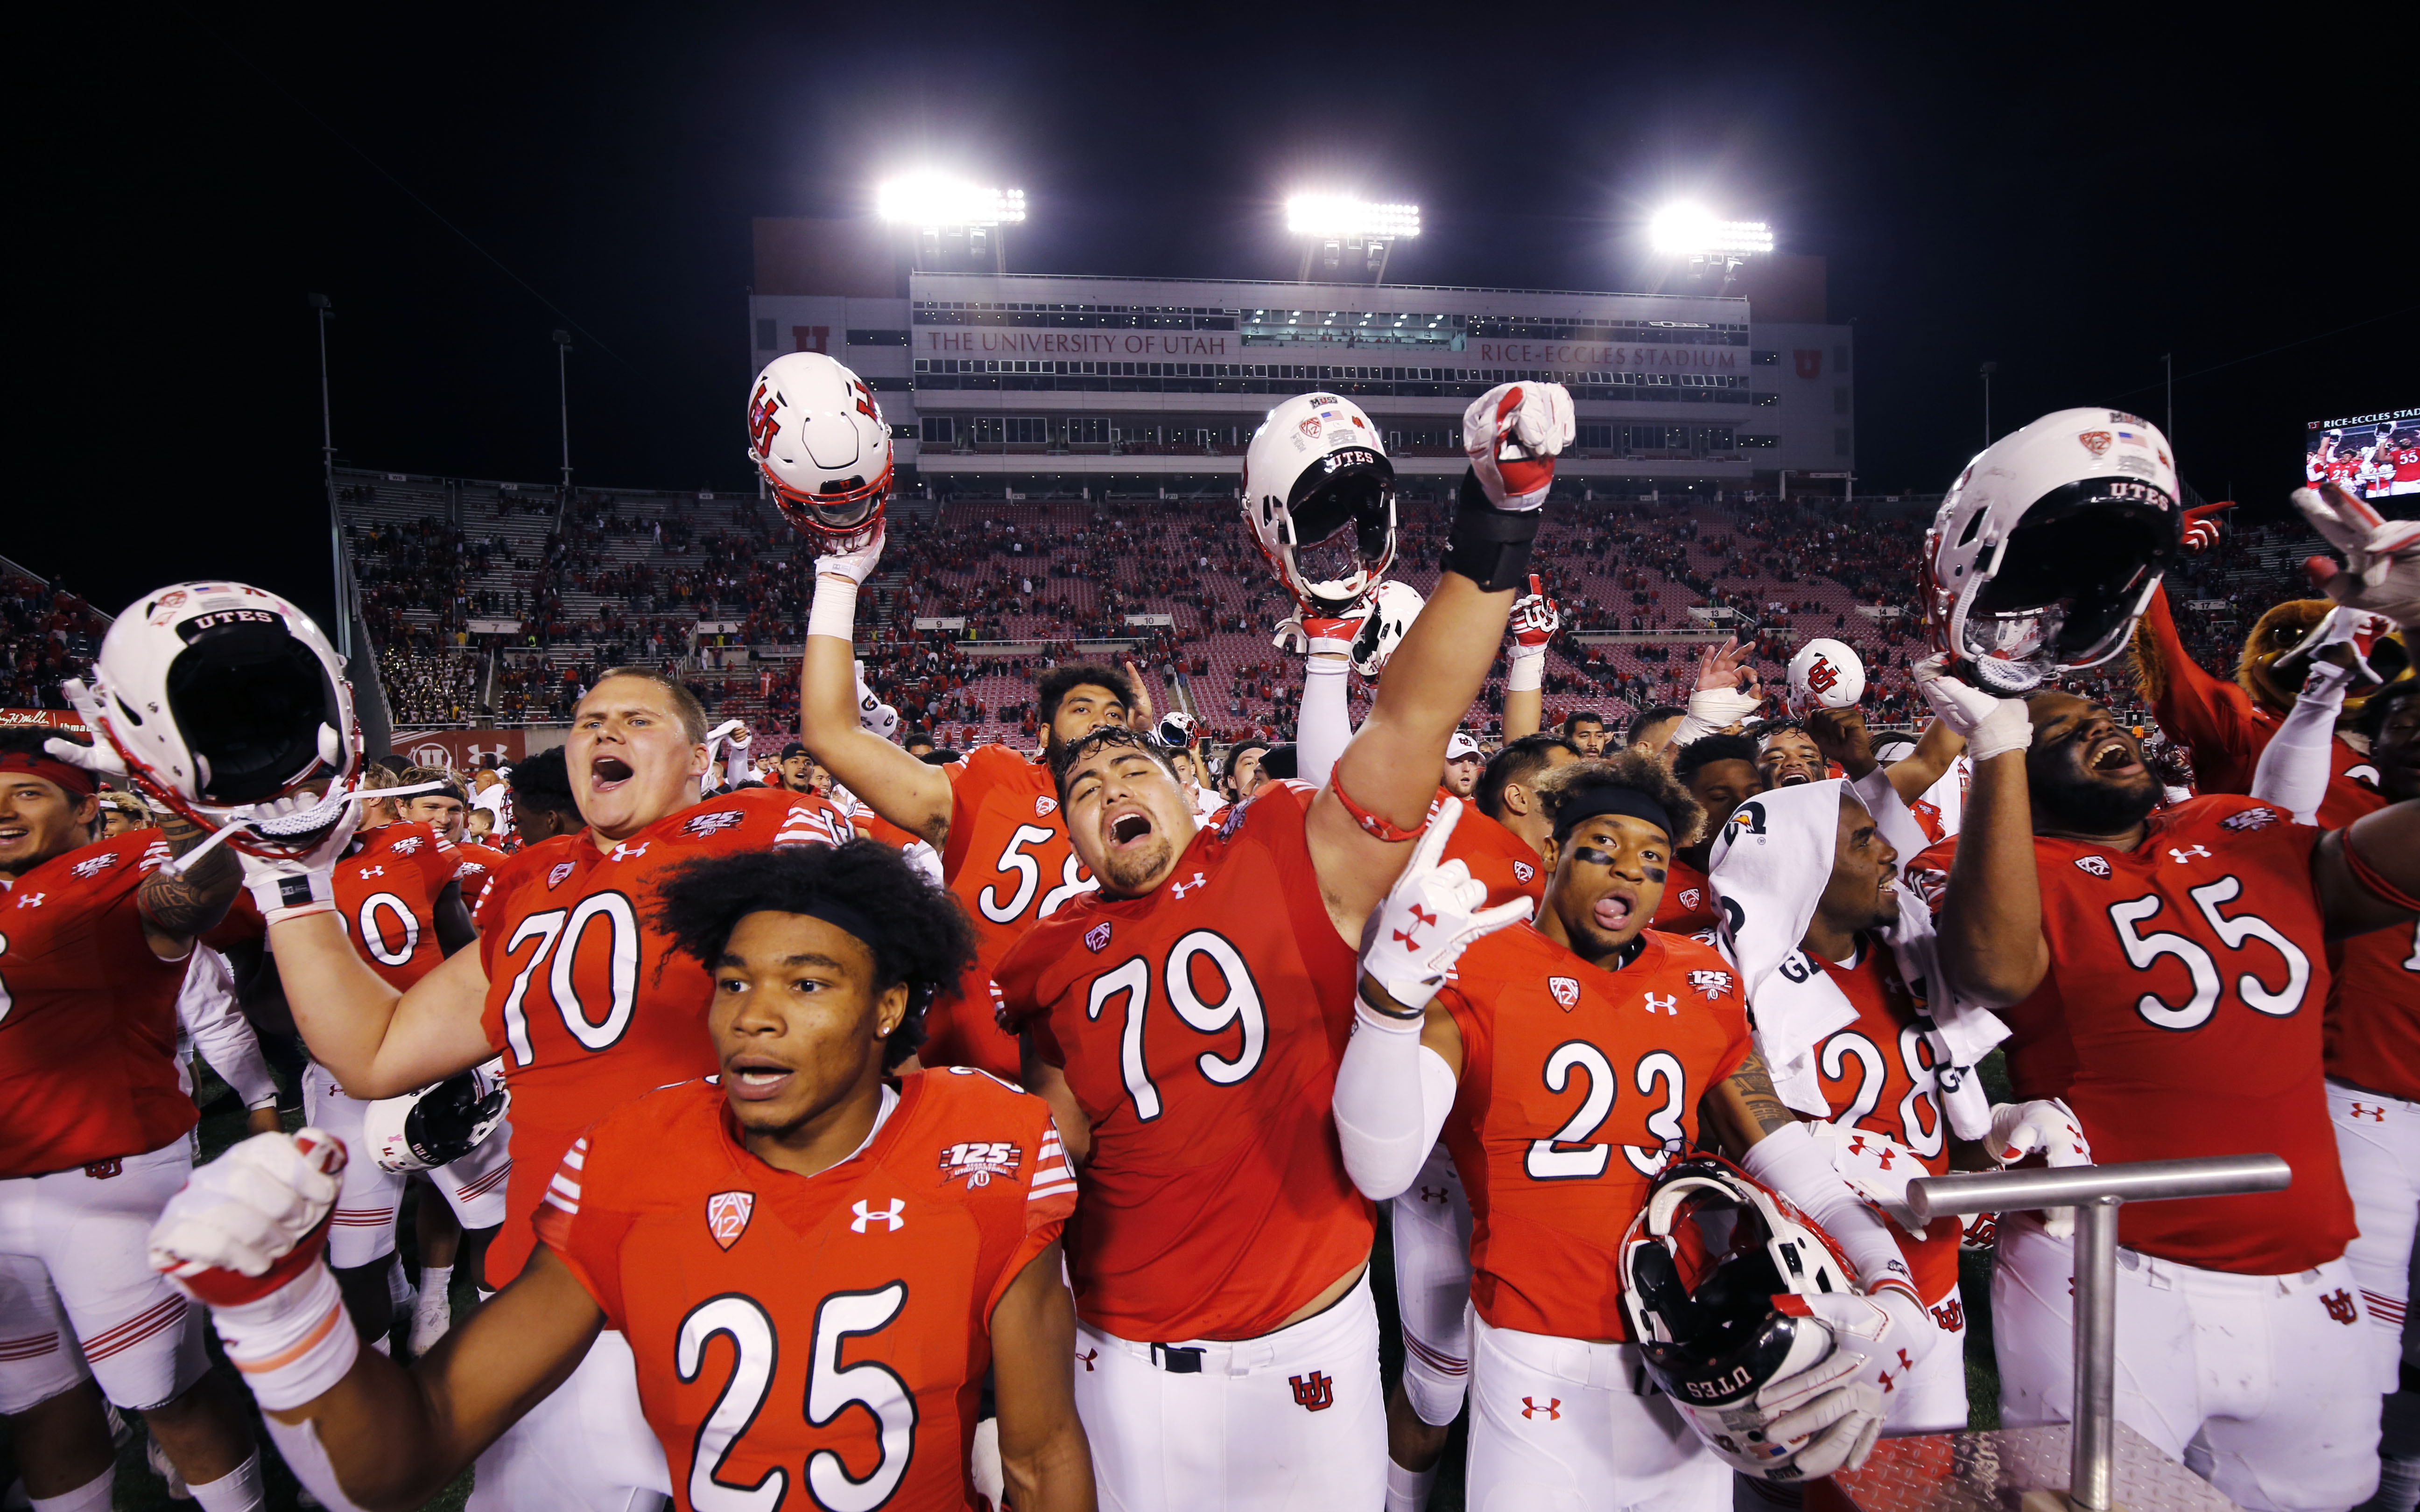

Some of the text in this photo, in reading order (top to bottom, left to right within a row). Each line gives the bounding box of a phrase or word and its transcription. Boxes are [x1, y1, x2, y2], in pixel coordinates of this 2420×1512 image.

[928, 331, 1225, 355] THE UNIVERSITY OF UTAH
[1481, 343, 1736, 368] RICE-ECCLES STADIUM
[1310, 397, 1338, 409] MUSS
[2323, 412, 2391, 428] RICE-ECCLES
[1308, 426, 1319, 435] 12
[1332, 451, 1374, 467] UTES
[2399, 452, 2419, 465] 55
[2331, 469, 2350, 481] 23
[2110, 483, 2169, 511] UTES
[194, 611, 273, 630] UTES
[1036, 795, 1058, 812] PAC
[1036, 805, 1049, 814] 12
[689, 810, 738, 826] 125
[2224, 807, 2268, 827] 125
[393, 836, 418, 851] 125
[77, 853, 112, 873] 125
[1514, 861, 1534, 879] PAC
[1517, 870, 1528, 882] 12
[1679, 889, 1700, 905] PAC
[1686, 897, 1698, 908] 12
[1085, 921, 1110, 948] PAC
[1092, 935, 1107, 952] 12
[2106, 874, 2312, 1033] 55
[504, 889, 641, 1067] 70
[1692, 970, 1727, 986] 125
[1549, 976, 1578, 999] PAC
[1558, 991, 1574, 1005] 12
[1087, 927, 1269, 1124] 79
[1819, 1023, 1944, 1160] 28
[1523, 1038, 1686, 1182] 23
[950, 1143, 1012, 1165] 125
[954, 1167, 974, 1176] UTAH
[977, 1173, 986, 1183] U
[709, 1192, 753, 1226] PAC
[715, 1216, 739, 1239] 12
[1686, 1365, 1752, 1398] UTES
[674, 1278, 919, 1512] 25
